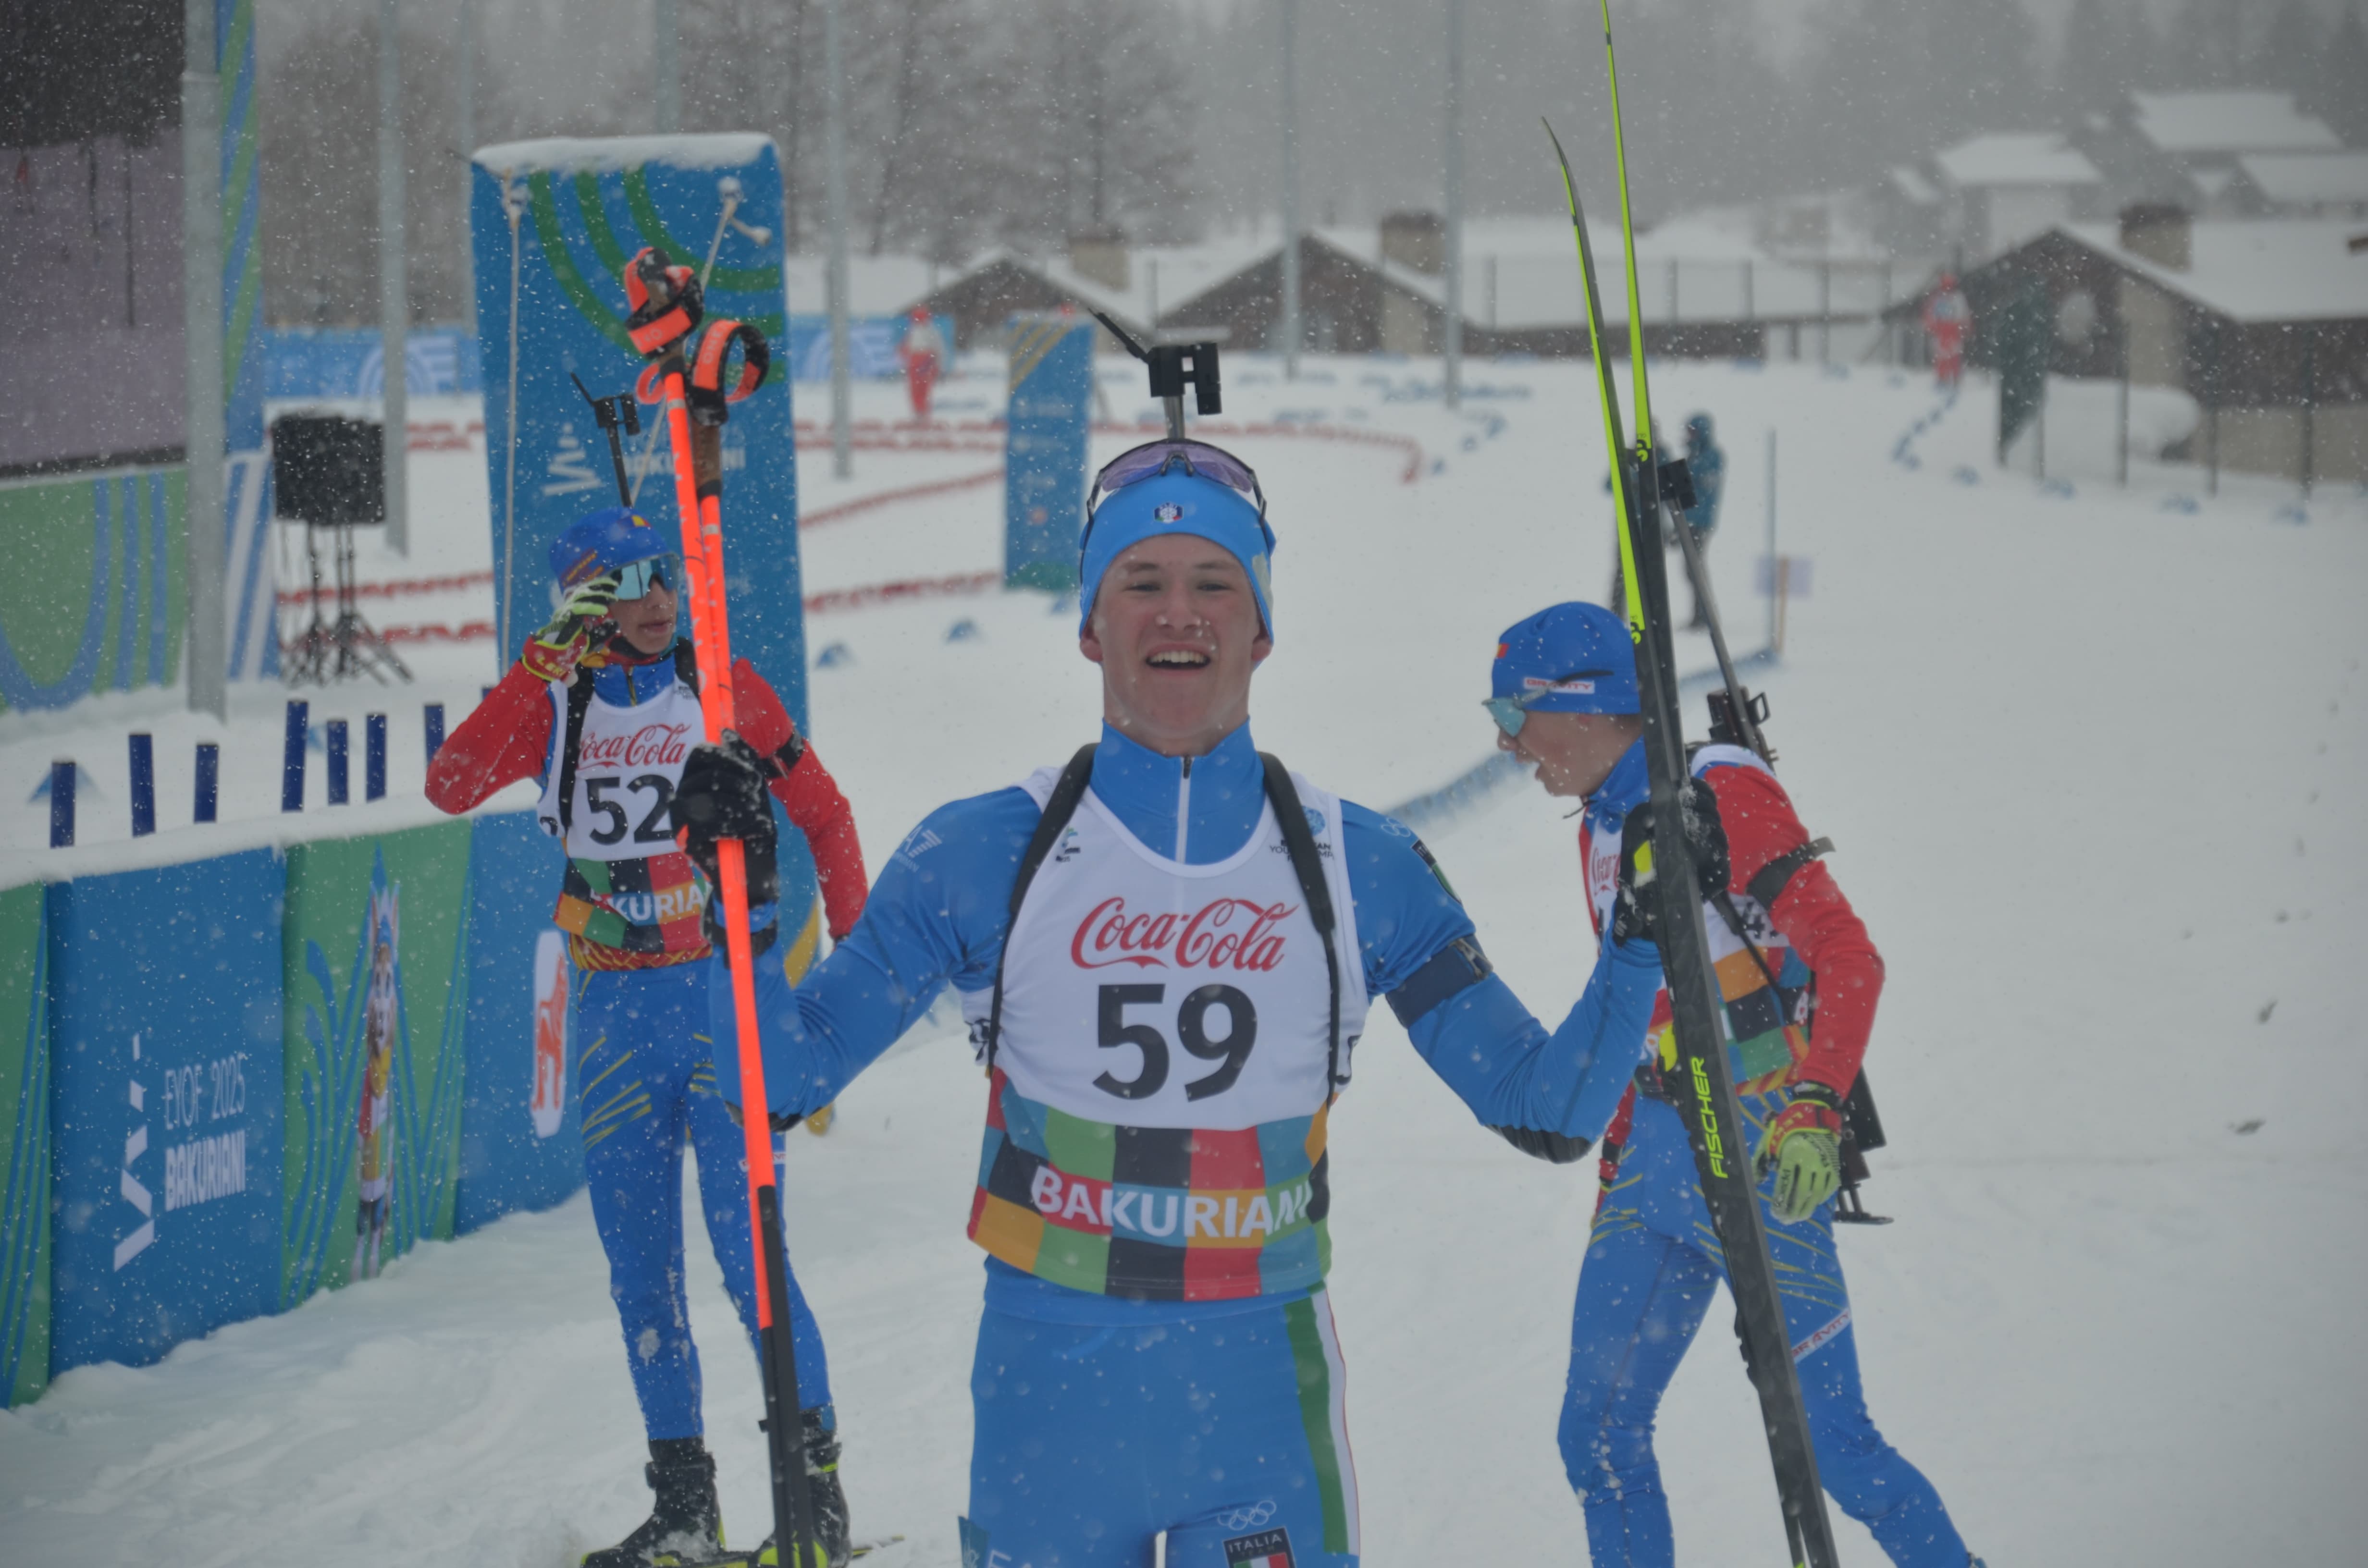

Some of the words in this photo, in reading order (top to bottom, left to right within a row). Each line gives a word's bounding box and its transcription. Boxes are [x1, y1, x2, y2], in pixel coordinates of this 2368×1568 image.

[585, 774, 675, 846] 52
[1071, 896, 1300, 971] Coca-Cola
[1092, 983, 1258, 1102] 59
[165, 1064, 203, 1130] EYOF
[210, 1052, 247, 1120] 2025
[1691, 1057, 1729, 1179] FISCHER
[164, 1129, 247, 1212] BAKURIANI
[1031, 1165, 1314, 1238] BAKURIANI
[1228, 1533, 1283, 1554] ITALIA
